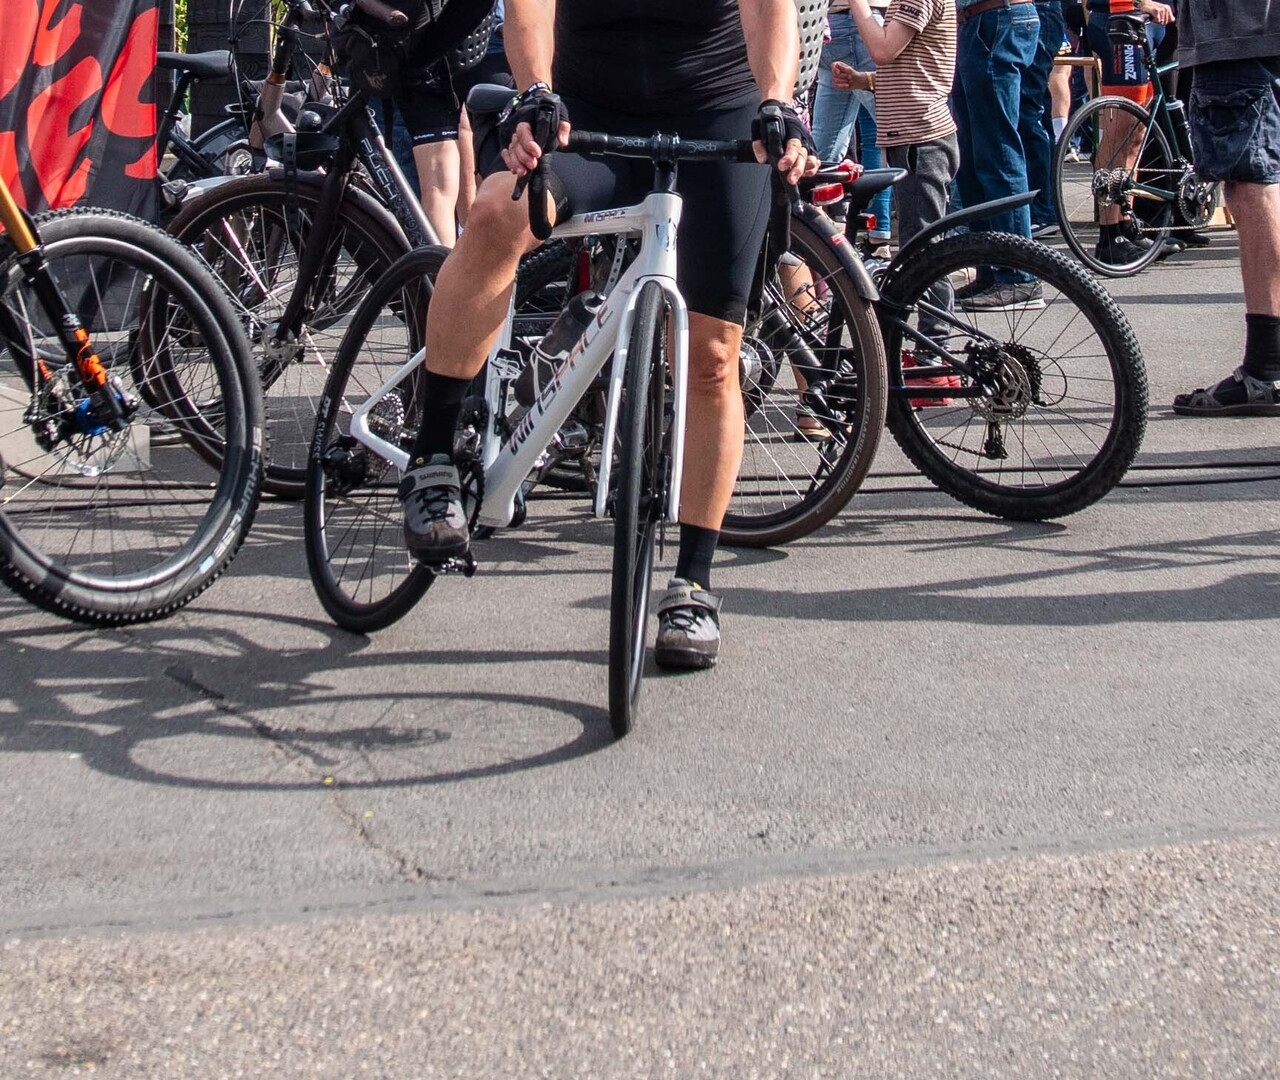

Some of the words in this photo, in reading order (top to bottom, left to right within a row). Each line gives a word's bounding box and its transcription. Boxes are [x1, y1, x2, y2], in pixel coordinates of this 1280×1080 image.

[1124, 44, 1137, 80] PINNRZ
[614, 136, 646, 149] Deda
[684, 141, 717, 153] Deda
[361, 137, 398, 200] PUCH
[213, 426, 263, 559] SCHWALBE
